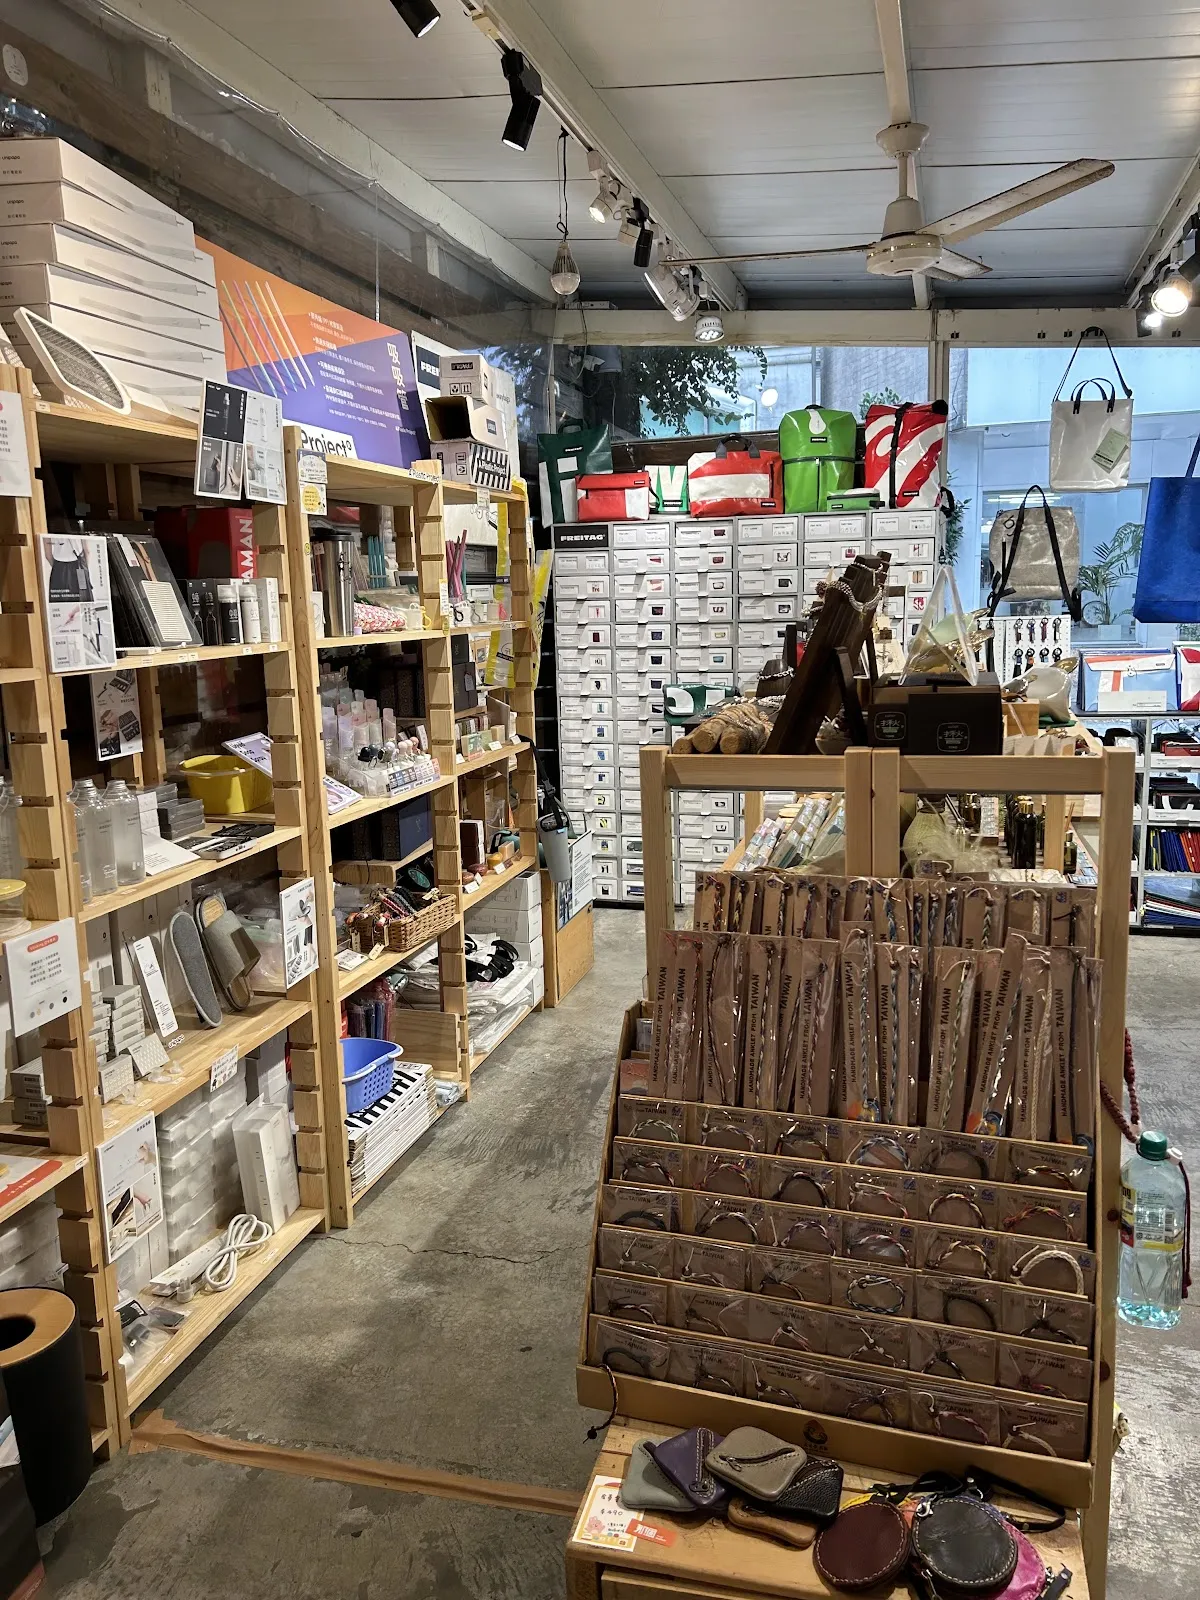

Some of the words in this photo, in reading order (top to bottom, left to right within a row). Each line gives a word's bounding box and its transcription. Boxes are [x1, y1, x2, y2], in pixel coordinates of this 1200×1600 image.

[560, 534, 605, 542] FREITAG
[676, 968, 686, 1004] TAIWAN
[750, 974, 760, 1011] TAIWAN
[779, 974, 793, 1010] TAIWAN
[844, 961, 853, 998] TAIWAN
[880, 984, 889, 1021] TAIWAN
[982, 990, 992, 1029] TAIWAN
[1024, 995, 1034, 1034] TAIWAN
[1056, 988, 1064, 1028] TAIWAN
[652, 1046, 660, 1082] HANDMADE
[657, 966, 667, 1001] TAIWAN
[799, 1062, 807, 1099] HANDMADE
[803, 979, 814, 1016] TAIWAN
[980, 1054, 992, 1093] HANDMADE
[989, 1031, 997, 1054] ANKLET
[997, 969, 1012, 1008] TAIWAN
[933, 1072, 942, 1112] HANDMADE
[940, 988, 952, 1024] TAIWAN
[645, 1107, 667, 1115] TAIWAN
[628, 1196, 651, 1204] TAIWAN
[723, 1205, 747, 1214] TAIWAN
[623, 1287, 647, 1296] TAIWAN
[1036, 1359, 1065, 1369] TAIWAN
[1029, 1415, 1058, 1425] TAIWAN
